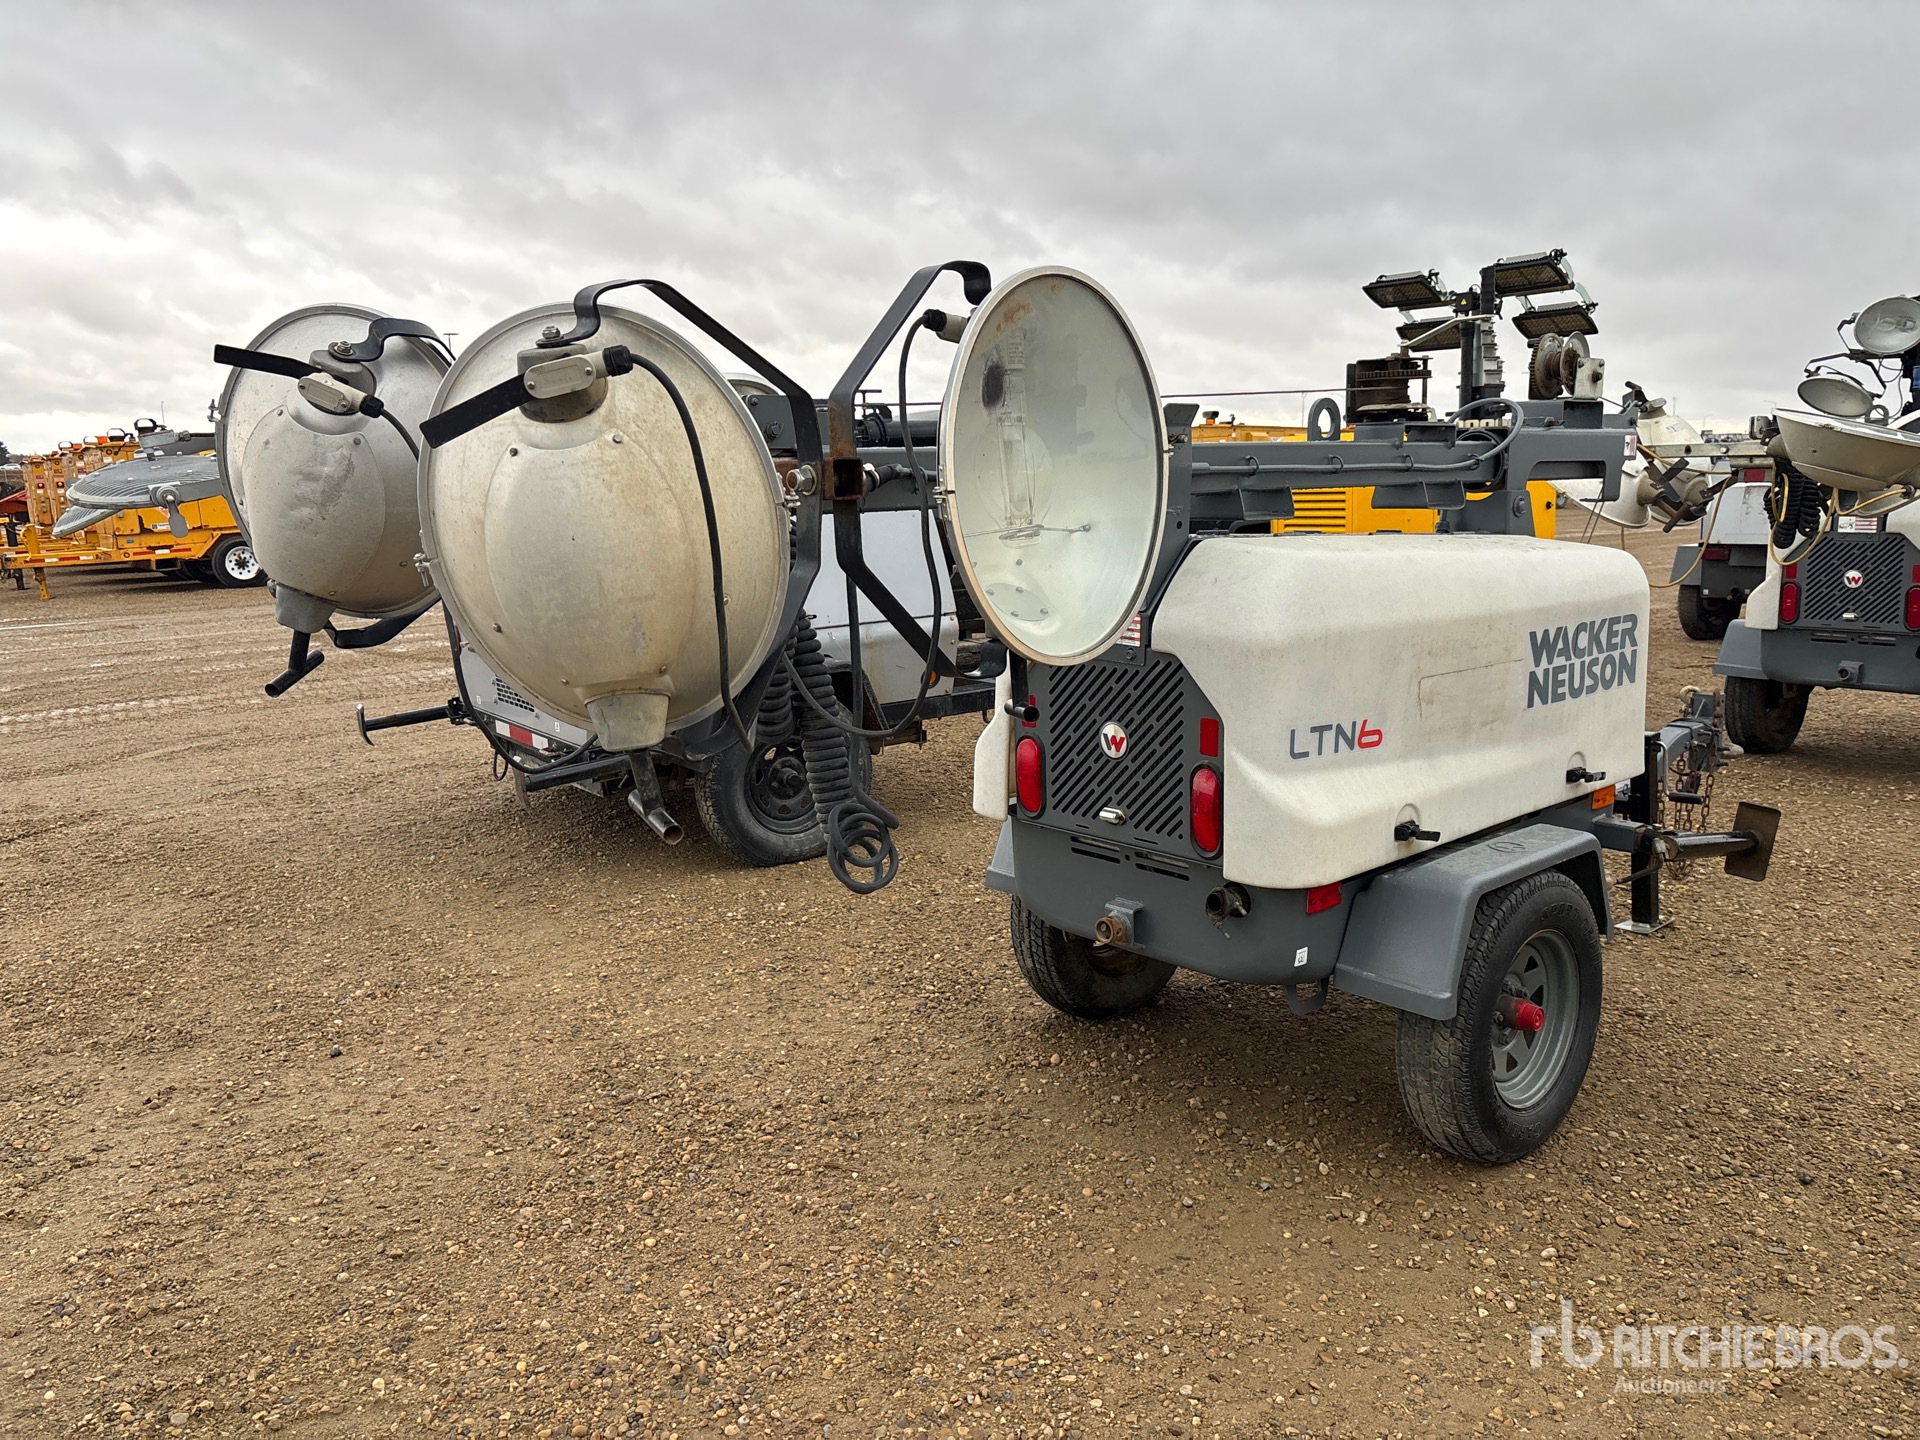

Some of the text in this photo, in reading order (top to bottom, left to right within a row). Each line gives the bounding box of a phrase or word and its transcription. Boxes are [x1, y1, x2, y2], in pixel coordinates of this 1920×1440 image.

[1528, 613, 1638, 668] WACKER
[1526, 648, 1638, 709] NEUSON
[1289, 718, 1384, 760] LTN6
